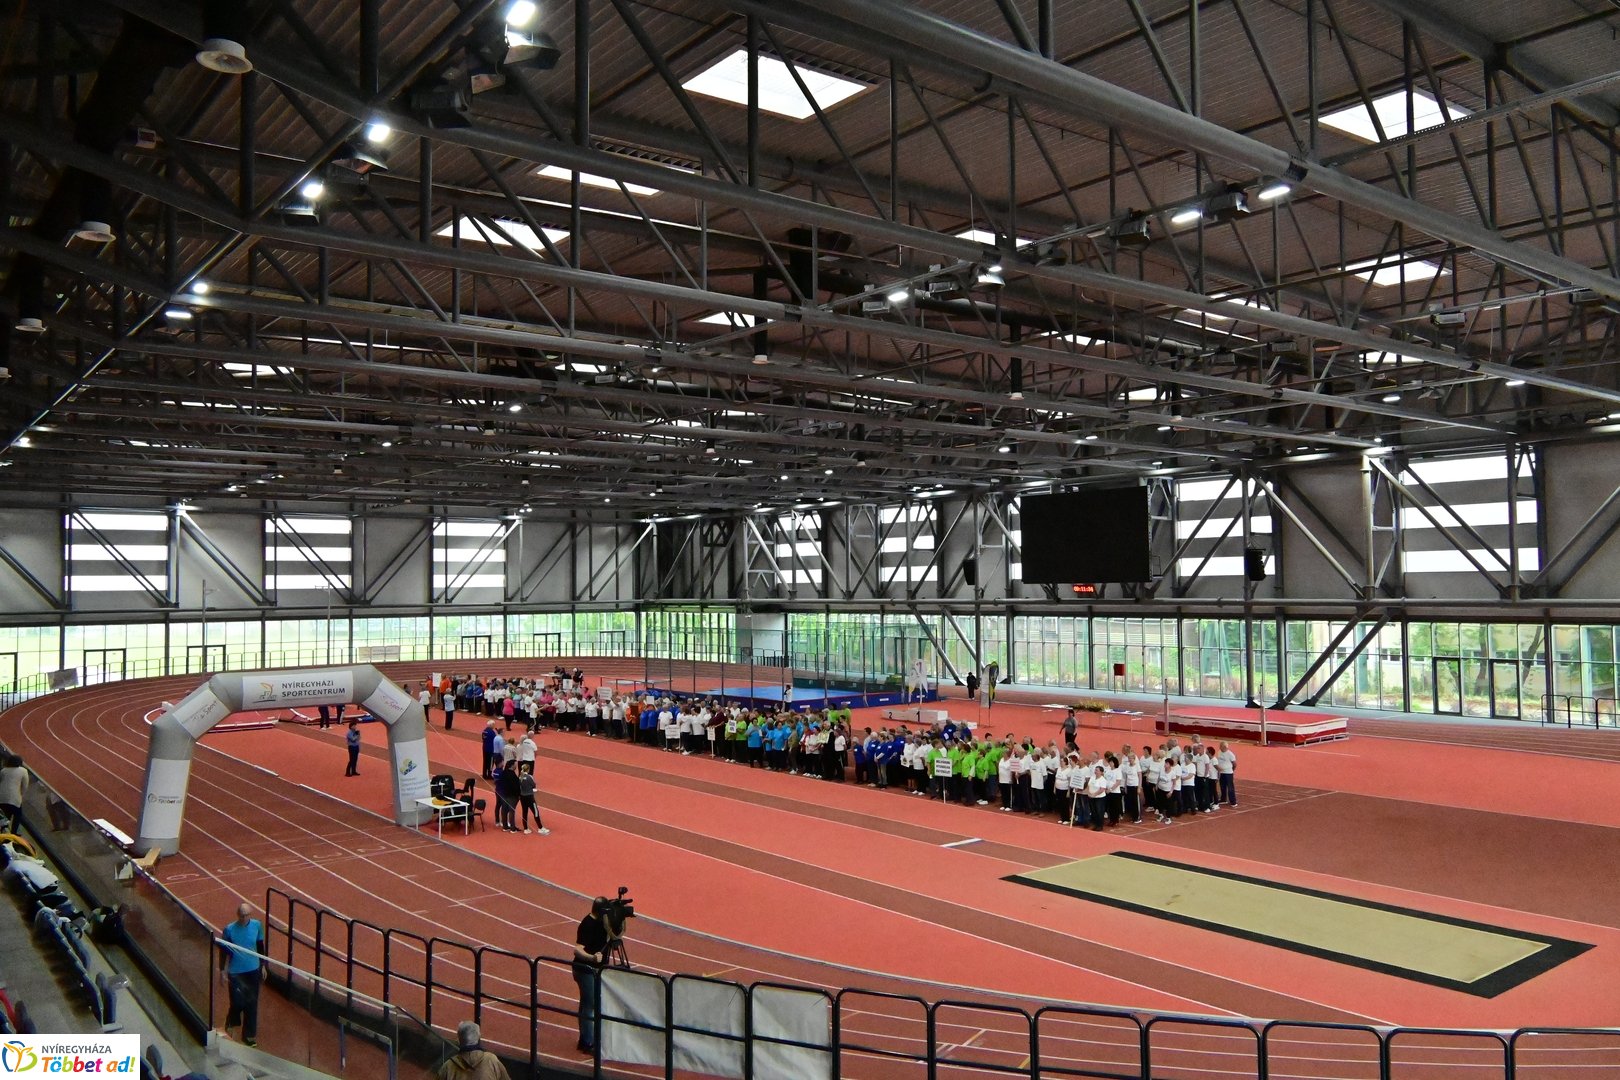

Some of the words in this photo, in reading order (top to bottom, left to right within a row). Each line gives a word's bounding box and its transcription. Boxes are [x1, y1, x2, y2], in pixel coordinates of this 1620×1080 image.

[281, 687, 346, 698] SPORTCENTRUM
[888, 711, 893, 720] 2
[916, 710, 921, 722] 1
